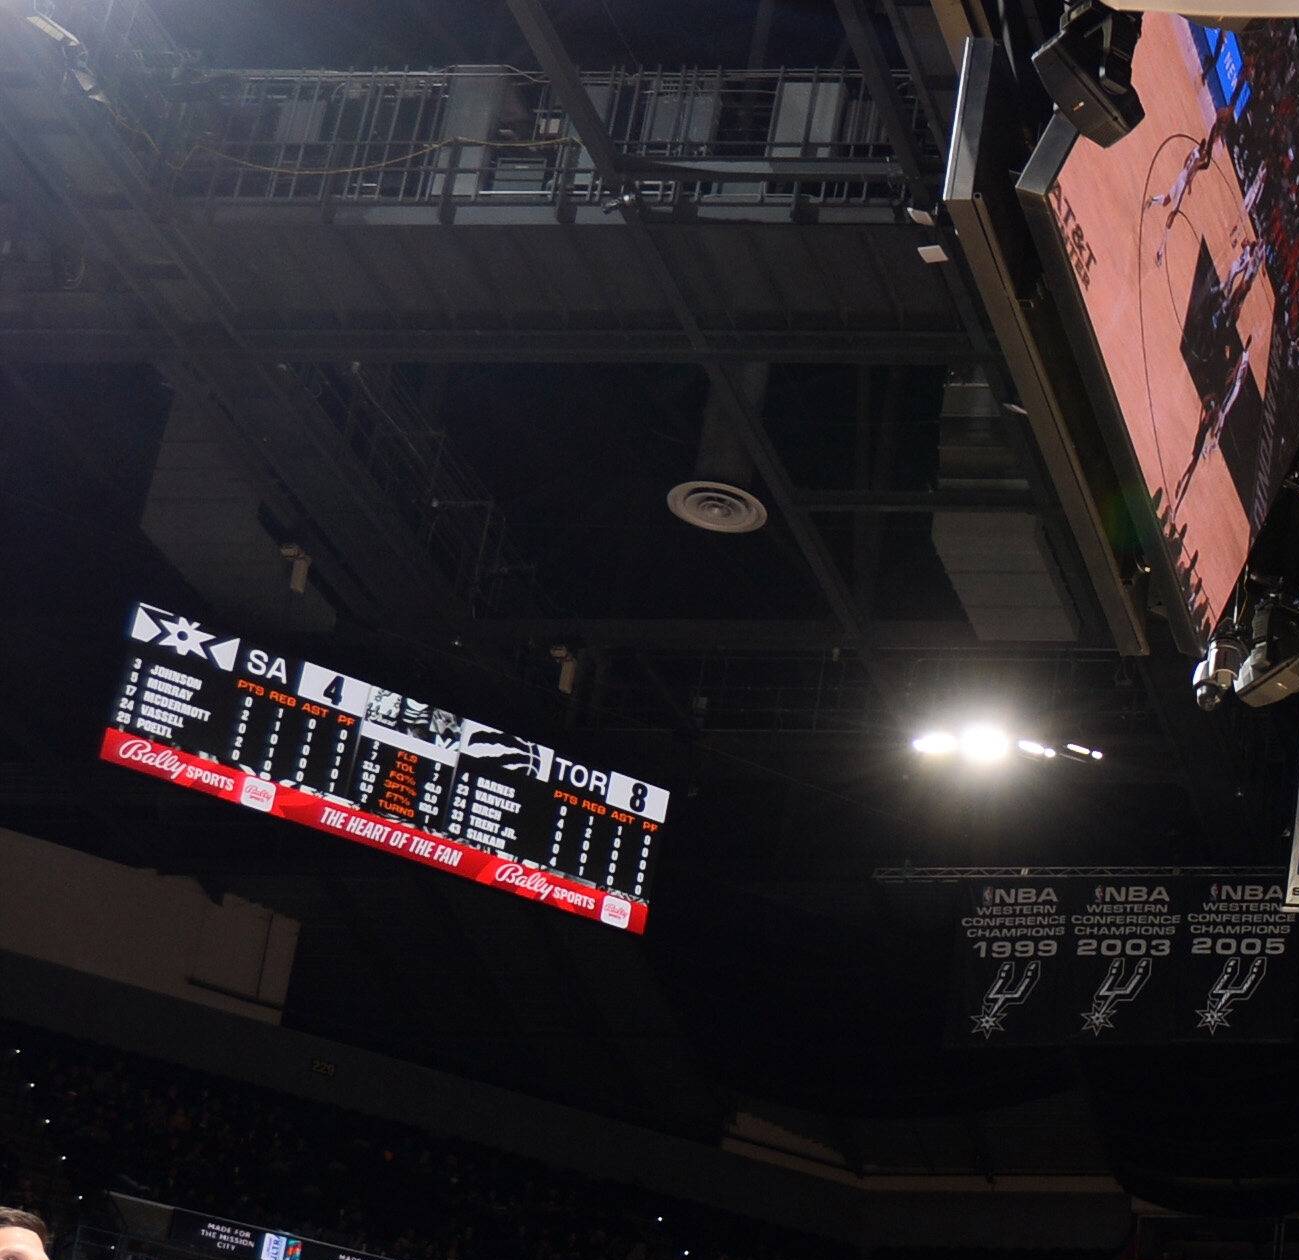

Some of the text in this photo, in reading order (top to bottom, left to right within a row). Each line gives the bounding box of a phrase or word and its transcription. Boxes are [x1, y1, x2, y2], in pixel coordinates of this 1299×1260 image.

[247, 649, 344, 706] SA 4
[118, 740, 234, 791] Bally SPORTS
[555, 757, 648, 813] TOR 8
[320, 807, 463, 867] THE HEART OF THE FAN
[495, 863, 595, 910] Bally SPORTS
[1105, 886, 1170, 902] NBA
[1221, 885, 1284, 900] NBA
[993, 887, 1058, 903] NBA
[976, 904, 1056, 915] WESTERN
[1086, 903, 1168, 913] WESTERN
[1202, 902, 1282, 912] WESTERN
[961, 915, 1066, 927] CONFERENCE
[1071, 914, 1181, 925] CONFERENCE
[1188, 912, 1296, 923] CONFERENCE
[967, 926, 1065, 938] CHAMPIONS
[1075, 925, 1176, 936] CHAMPIONS
[1190, 923, 1291, 934] CHAMPIONS
[972, 940, 1058, 958] 1999
[1076, 939, 1170, 957] 2003
[1191, 937, 1285, 955] 2005
